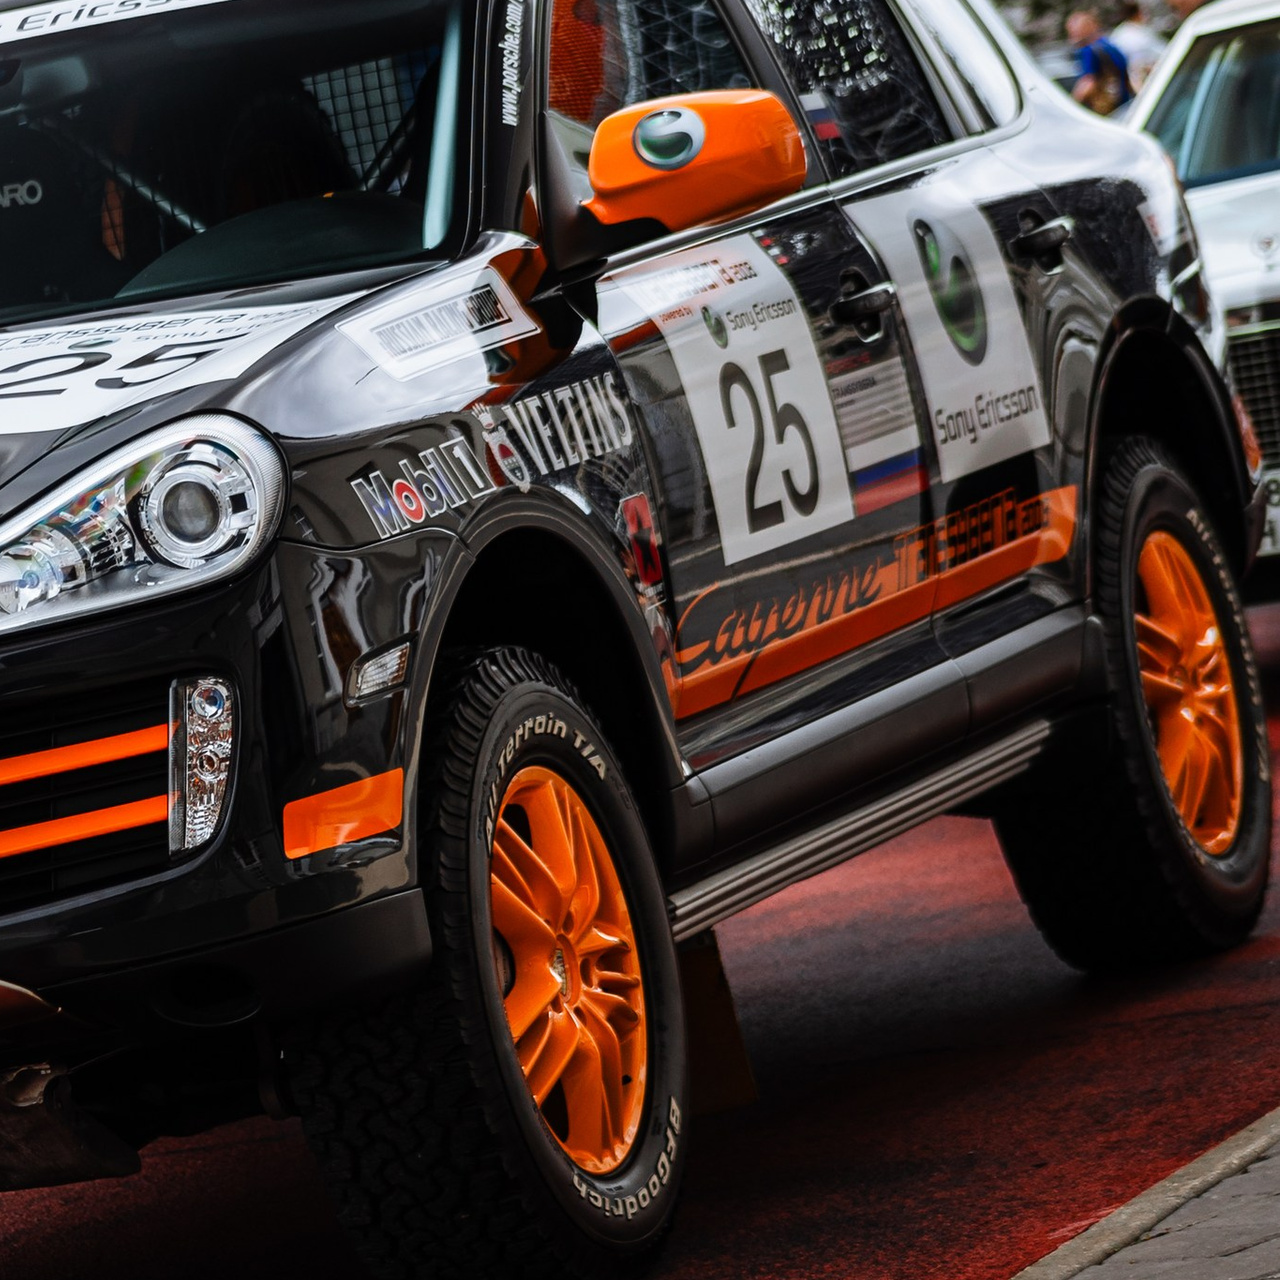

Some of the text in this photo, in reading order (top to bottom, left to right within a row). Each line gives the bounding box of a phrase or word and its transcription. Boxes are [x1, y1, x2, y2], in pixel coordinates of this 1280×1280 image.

[726, 298, 796, 332] Sony Ericsson
[502, 371, 633, 476] VELTINS
[719, 348, 820, 535] 25
[934, 383, 1040, 448] Sony Ericsson
[350, 448, 467, 540] Mobil
[573, 1096, 681, 1219] BFGoodrich
